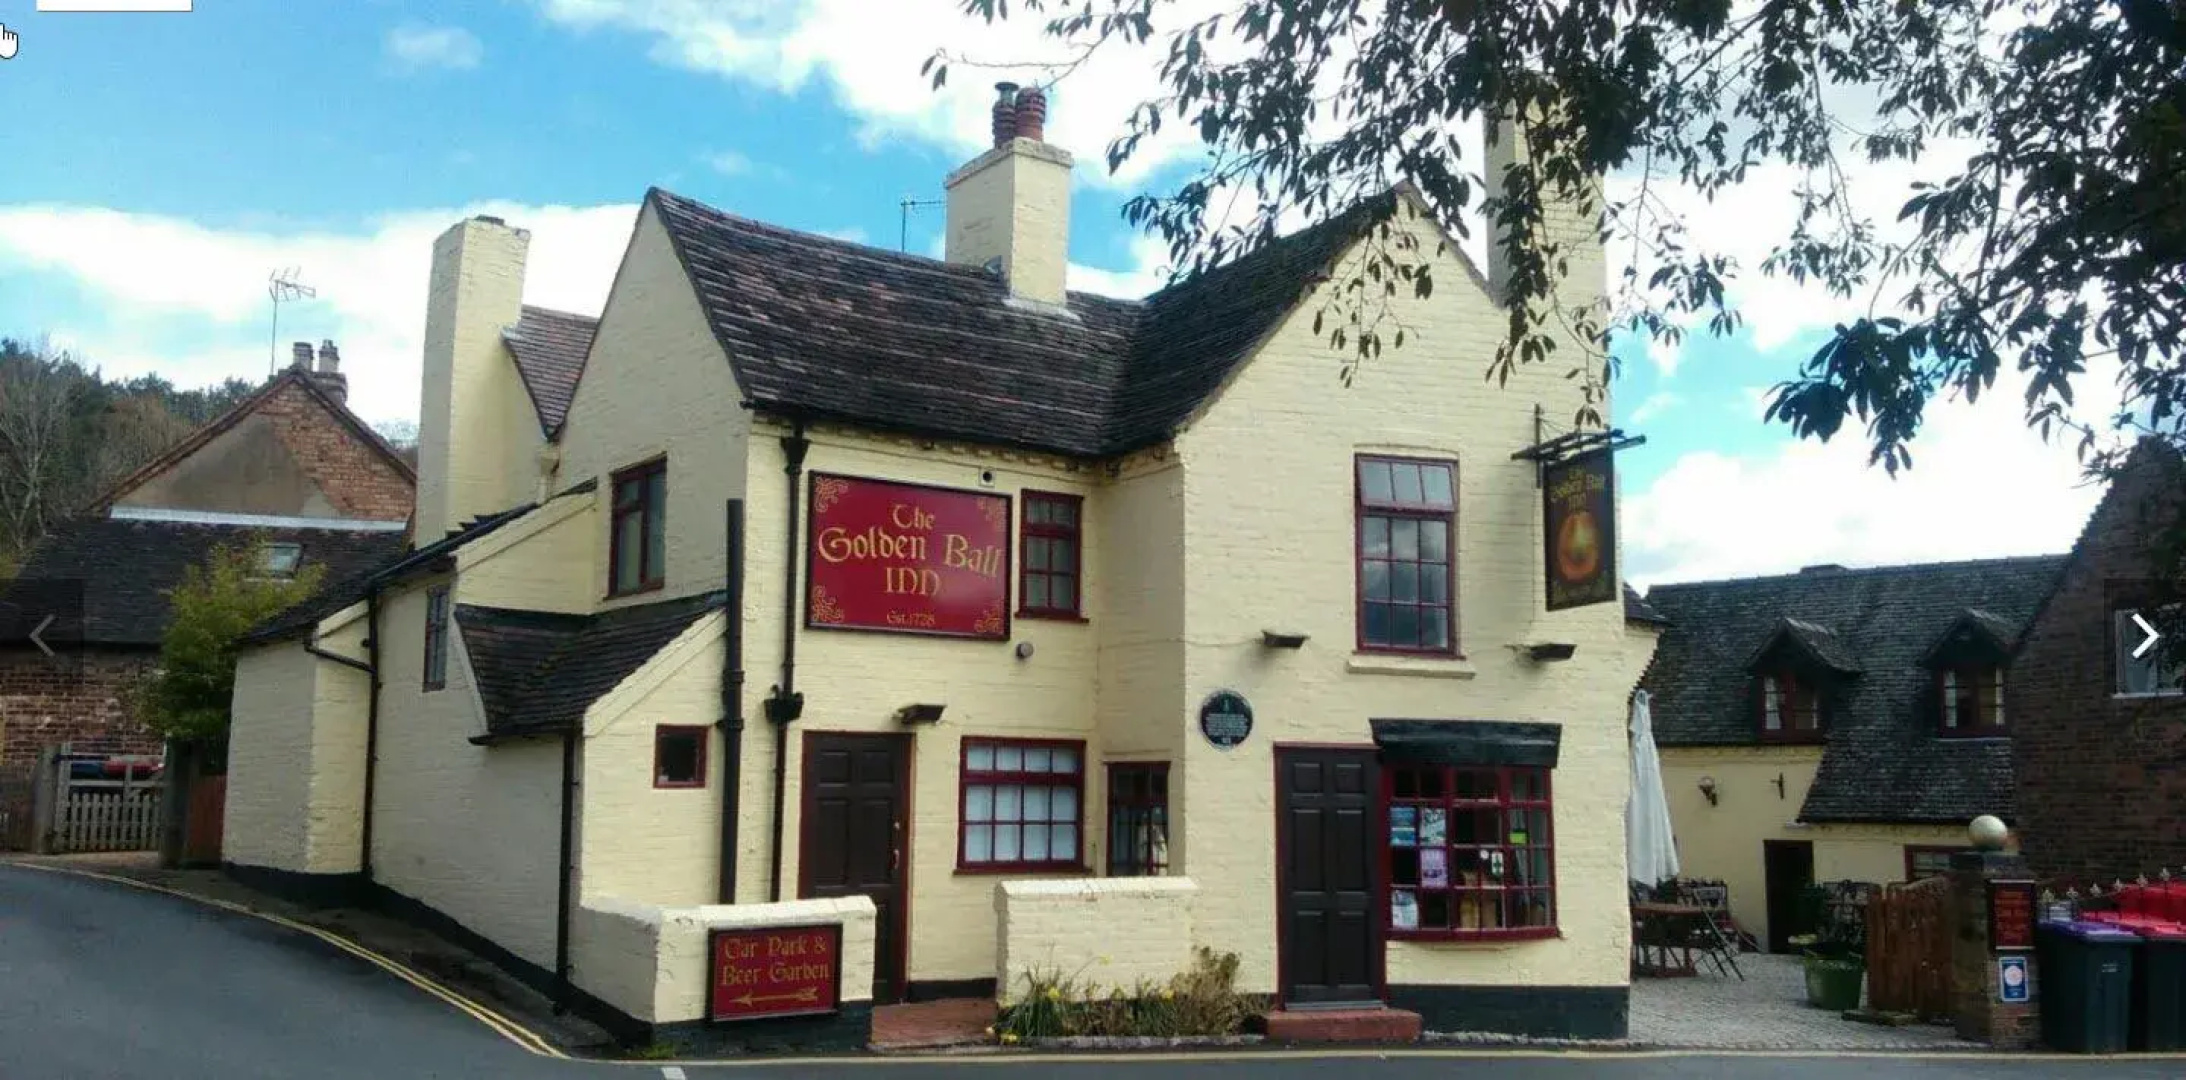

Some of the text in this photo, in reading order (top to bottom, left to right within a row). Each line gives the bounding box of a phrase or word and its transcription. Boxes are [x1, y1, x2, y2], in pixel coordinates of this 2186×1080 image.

[892, 503, 936, 530] The
[818, 526, 1001, 578] Golden Ball
[725, 935, 827, 959] Car Park &
[722, 962, 830, 986] Beer Garden
